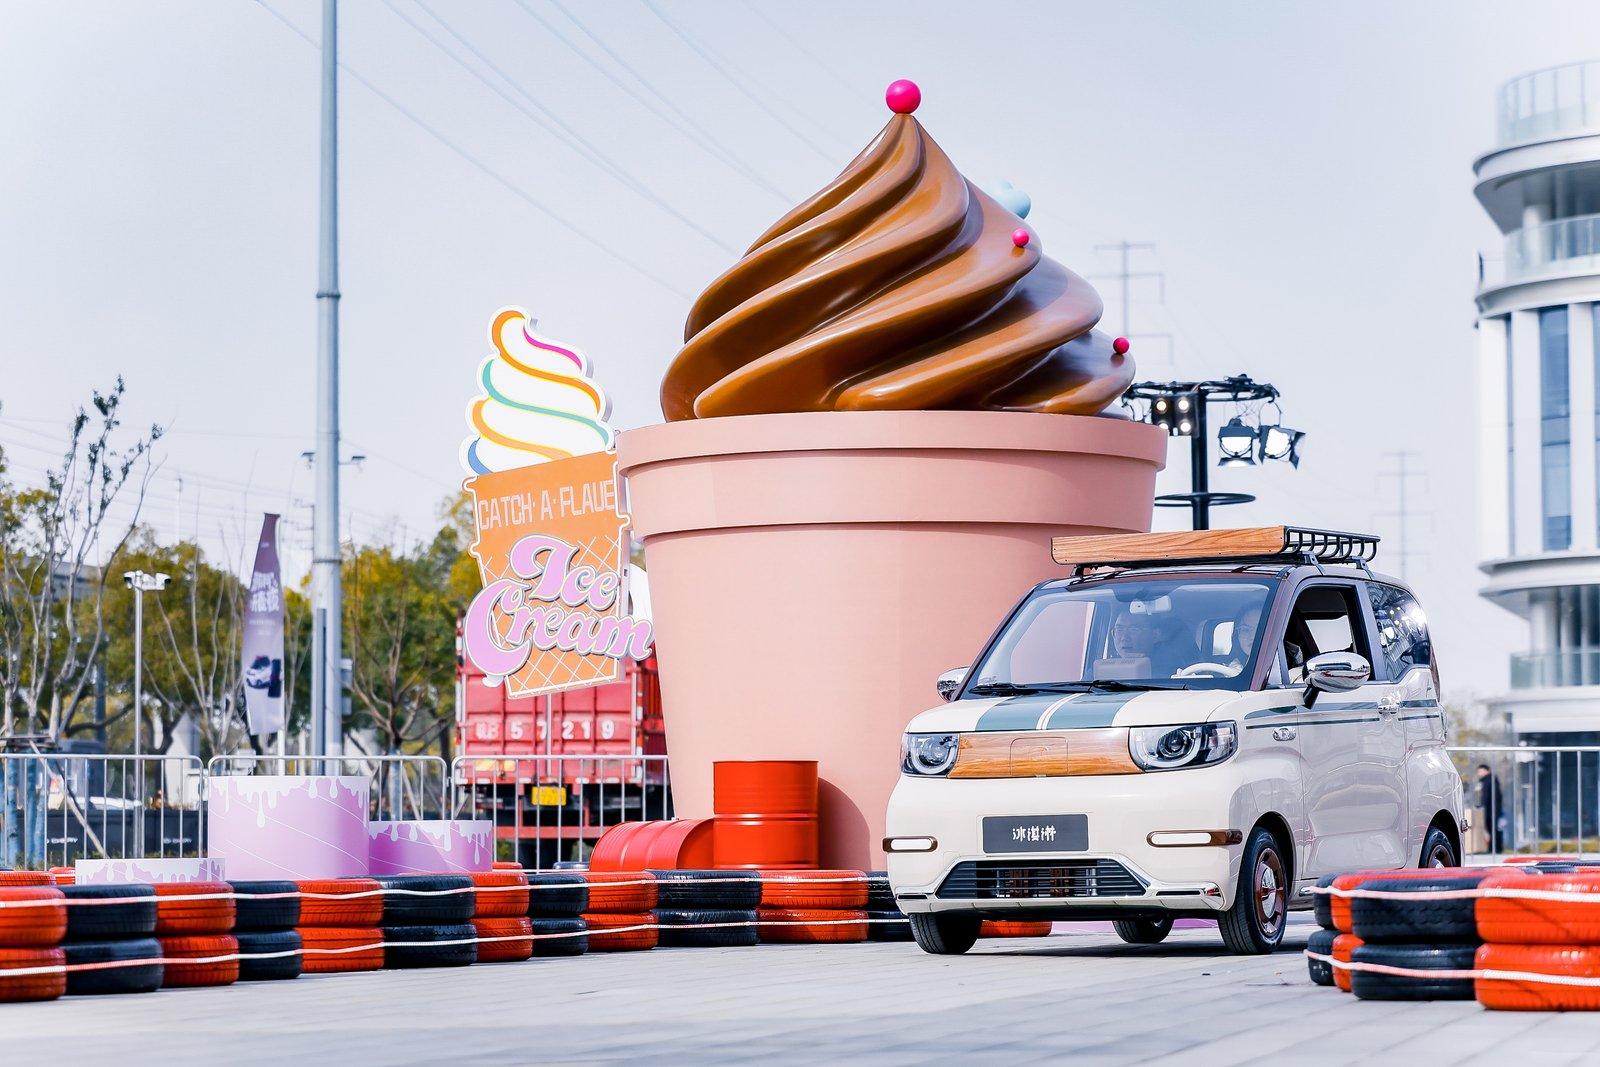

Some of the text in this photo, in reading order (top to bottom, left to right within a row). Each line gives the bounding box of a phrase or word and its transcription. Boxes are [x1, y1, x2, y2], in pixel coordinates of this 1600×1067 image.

[510, 534, 620, 610] Ice
[465, 578, 653, 676] Cream
[1012, 825, 1056, 842] 冰淇淋
